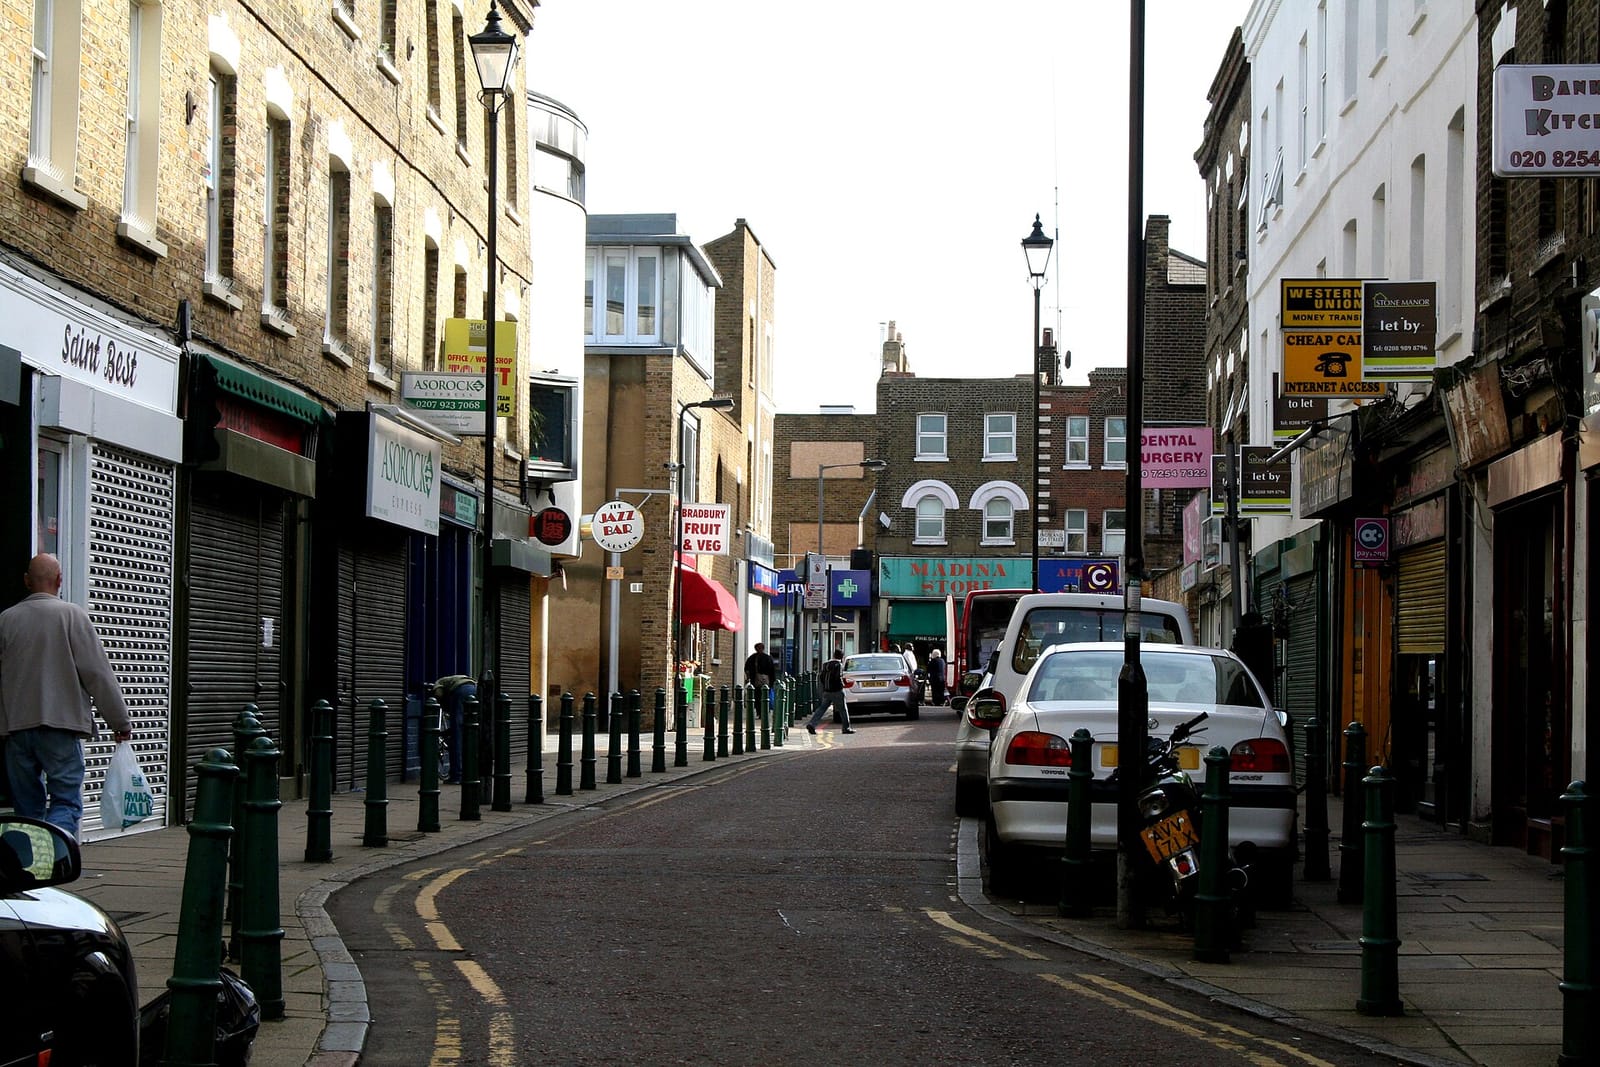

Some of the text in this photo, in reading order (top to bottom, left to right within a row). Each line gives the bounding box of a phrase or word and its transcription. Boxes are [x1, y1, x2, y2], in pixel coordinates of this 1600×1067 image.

[1510, 150, 1600, 167] 020 8254
[1289, 288, 1362, 298] WESTERN
[1314, 299, 1362, 309] UNION
[1401, 298, 1430, 306] MANOR
[1380, 320, 1420, 334] let by
[1286, 335, 1333, 346] CHEAP
[62, 323, 137, 388] Saint Best
[447, 354, 468, 362] OFFICE
[475, 356, 513, 365] WOSHOP
[413, 380, 474, 391] ASOROCK
[1285, 382, 1380, 393] INTERNET ACCESS
[440, 401, 456, 409] 923
[459, 401, 480, 409] 7068
[1288, 398, 1313, 409] to let
[381, 439, 428, 493] ASOROCK
[1151, 469, 1178, 478] 7254
[1180, 468, 1208, 478] 7322
[1252, 472, 1280, 483] let by
[599, 510, 635, 524] JAZZ
[682, 508, 726, 519] BRADBURY
[603, 523, 632, 536] BAR
[684, 522, 721, 535] FRUIT
[683, 539, 721, 551] & VEG
[910, 562, 1007, 577] MADINA
[1153, 816, 1182, 846] AVV
